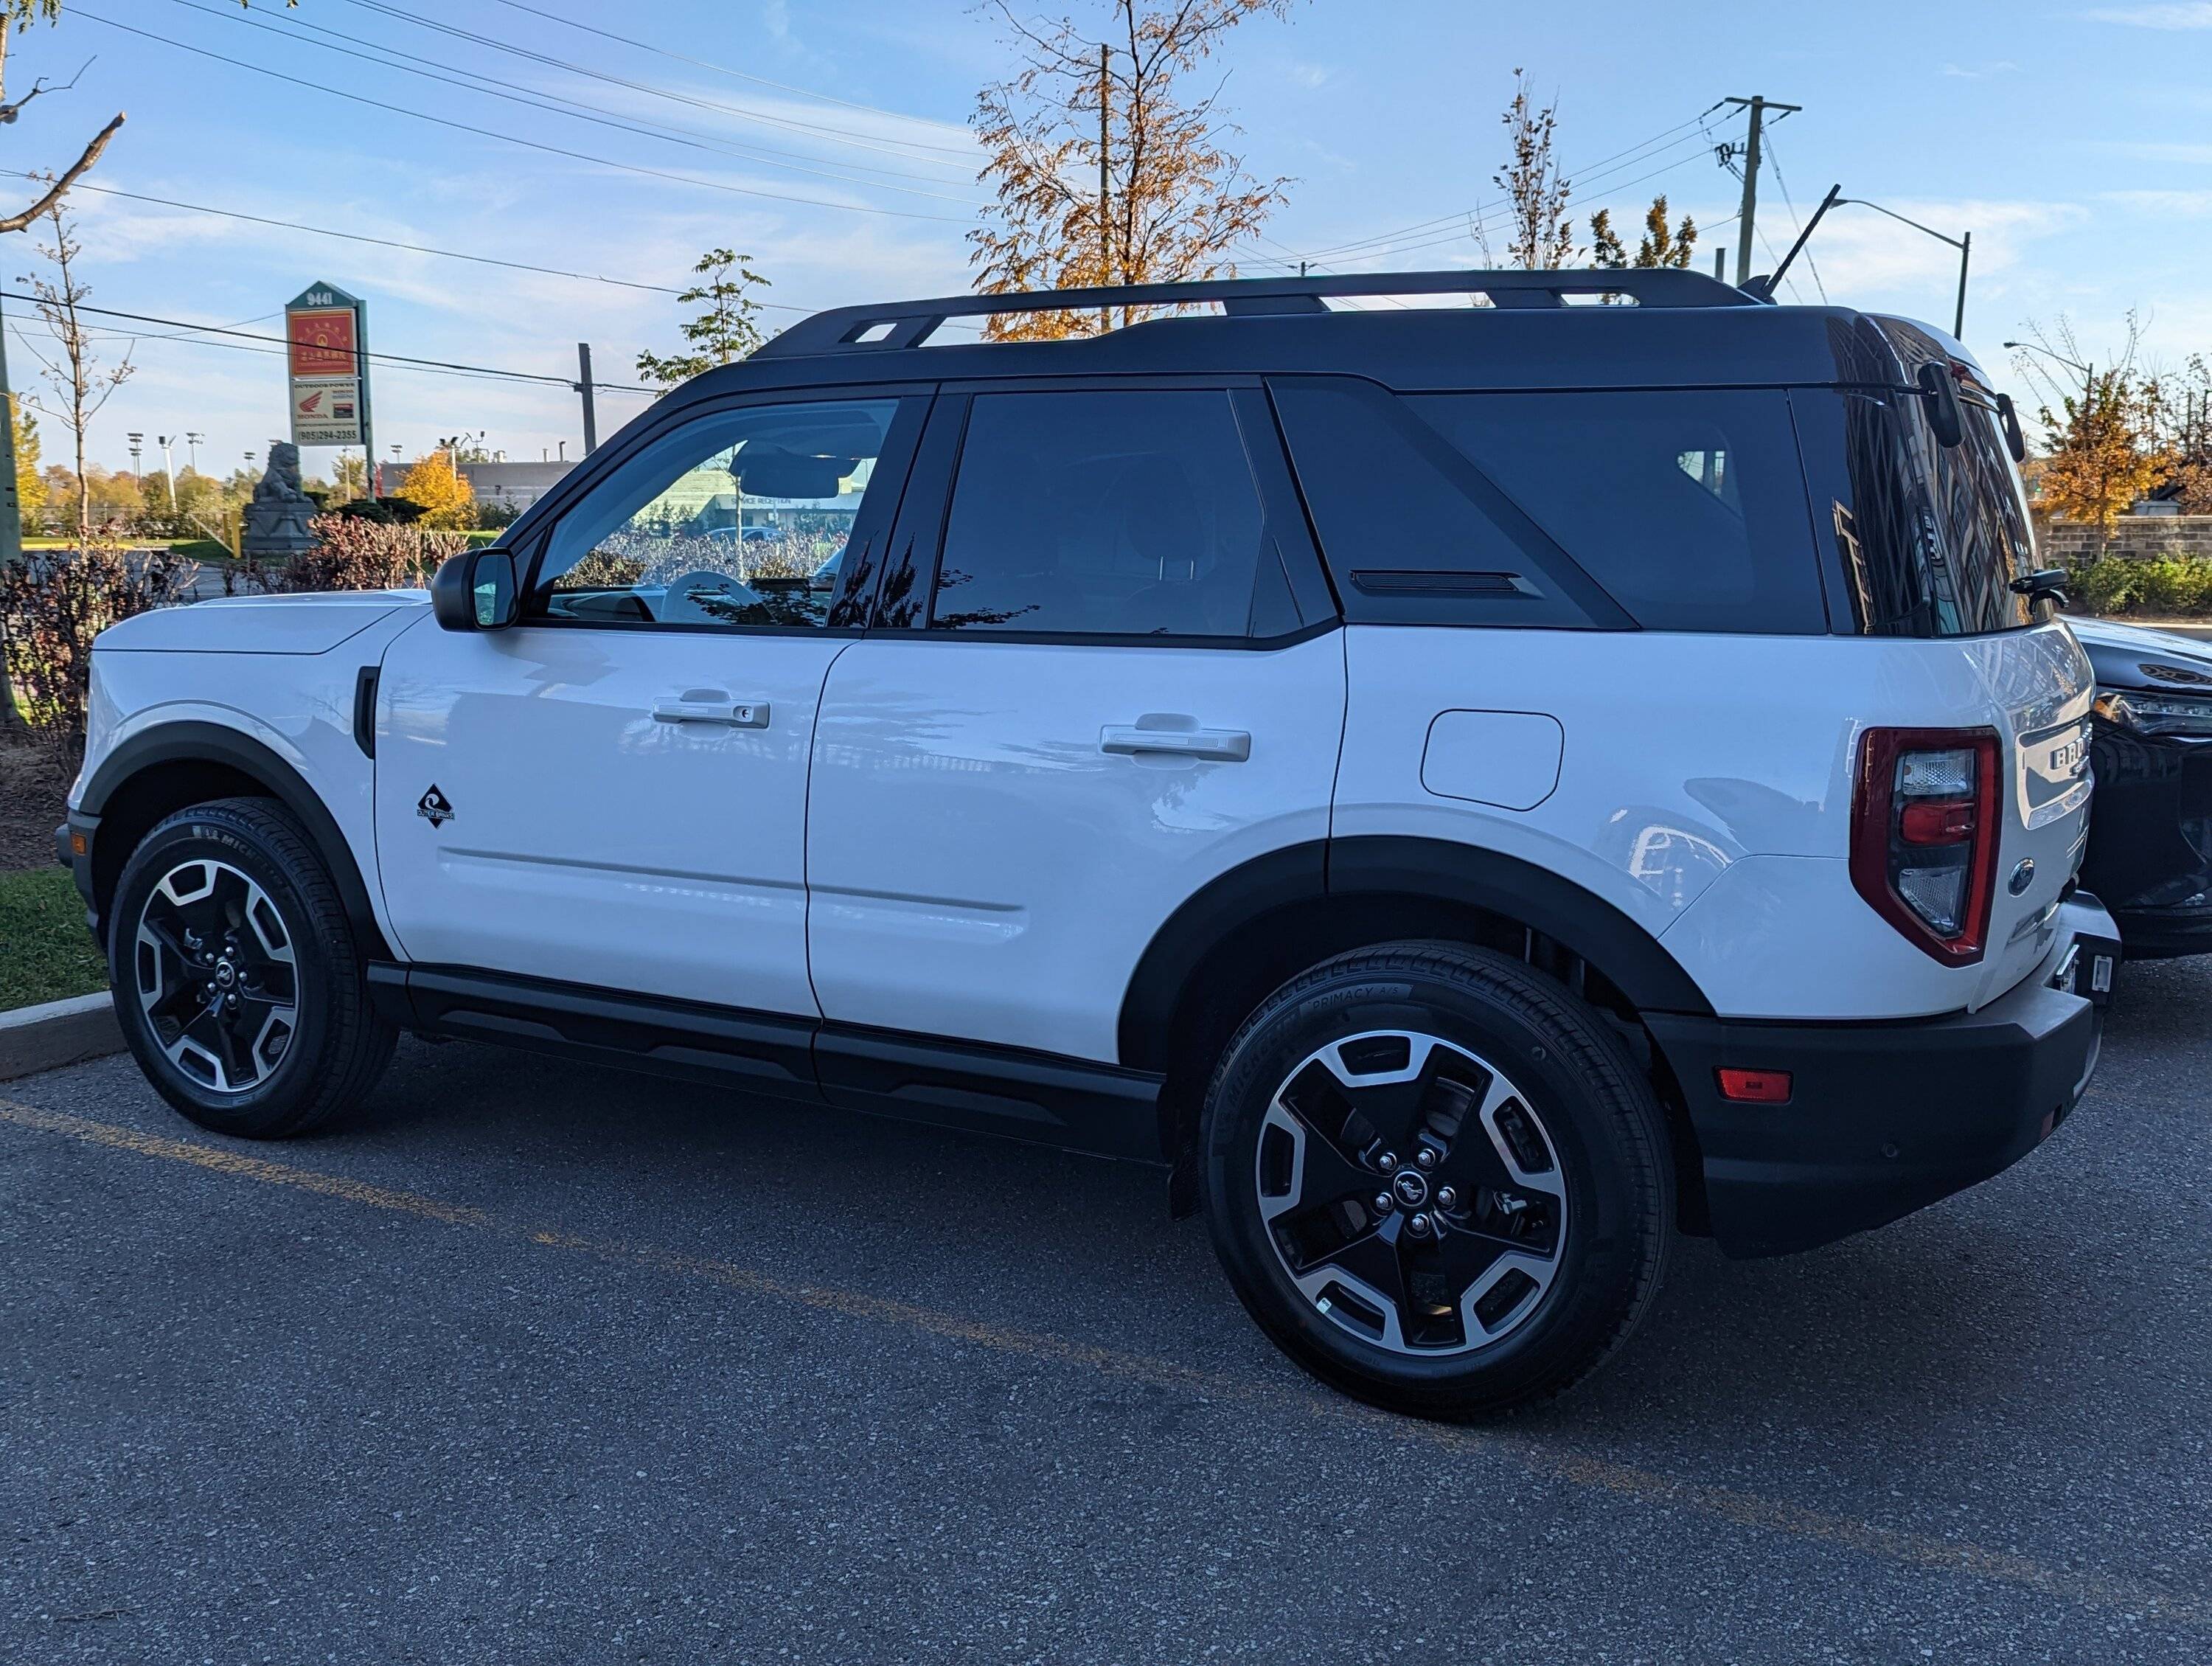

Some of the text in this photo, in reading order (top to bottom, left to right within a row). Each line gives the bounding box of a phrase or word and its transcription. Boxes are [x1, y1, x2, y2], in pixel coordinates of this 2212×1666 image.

[307, 292, 333, 305] 9441
[298, 430, 357, 441] (905)294-2355
[1313, 987, 1375, 1010] PRIMACY
